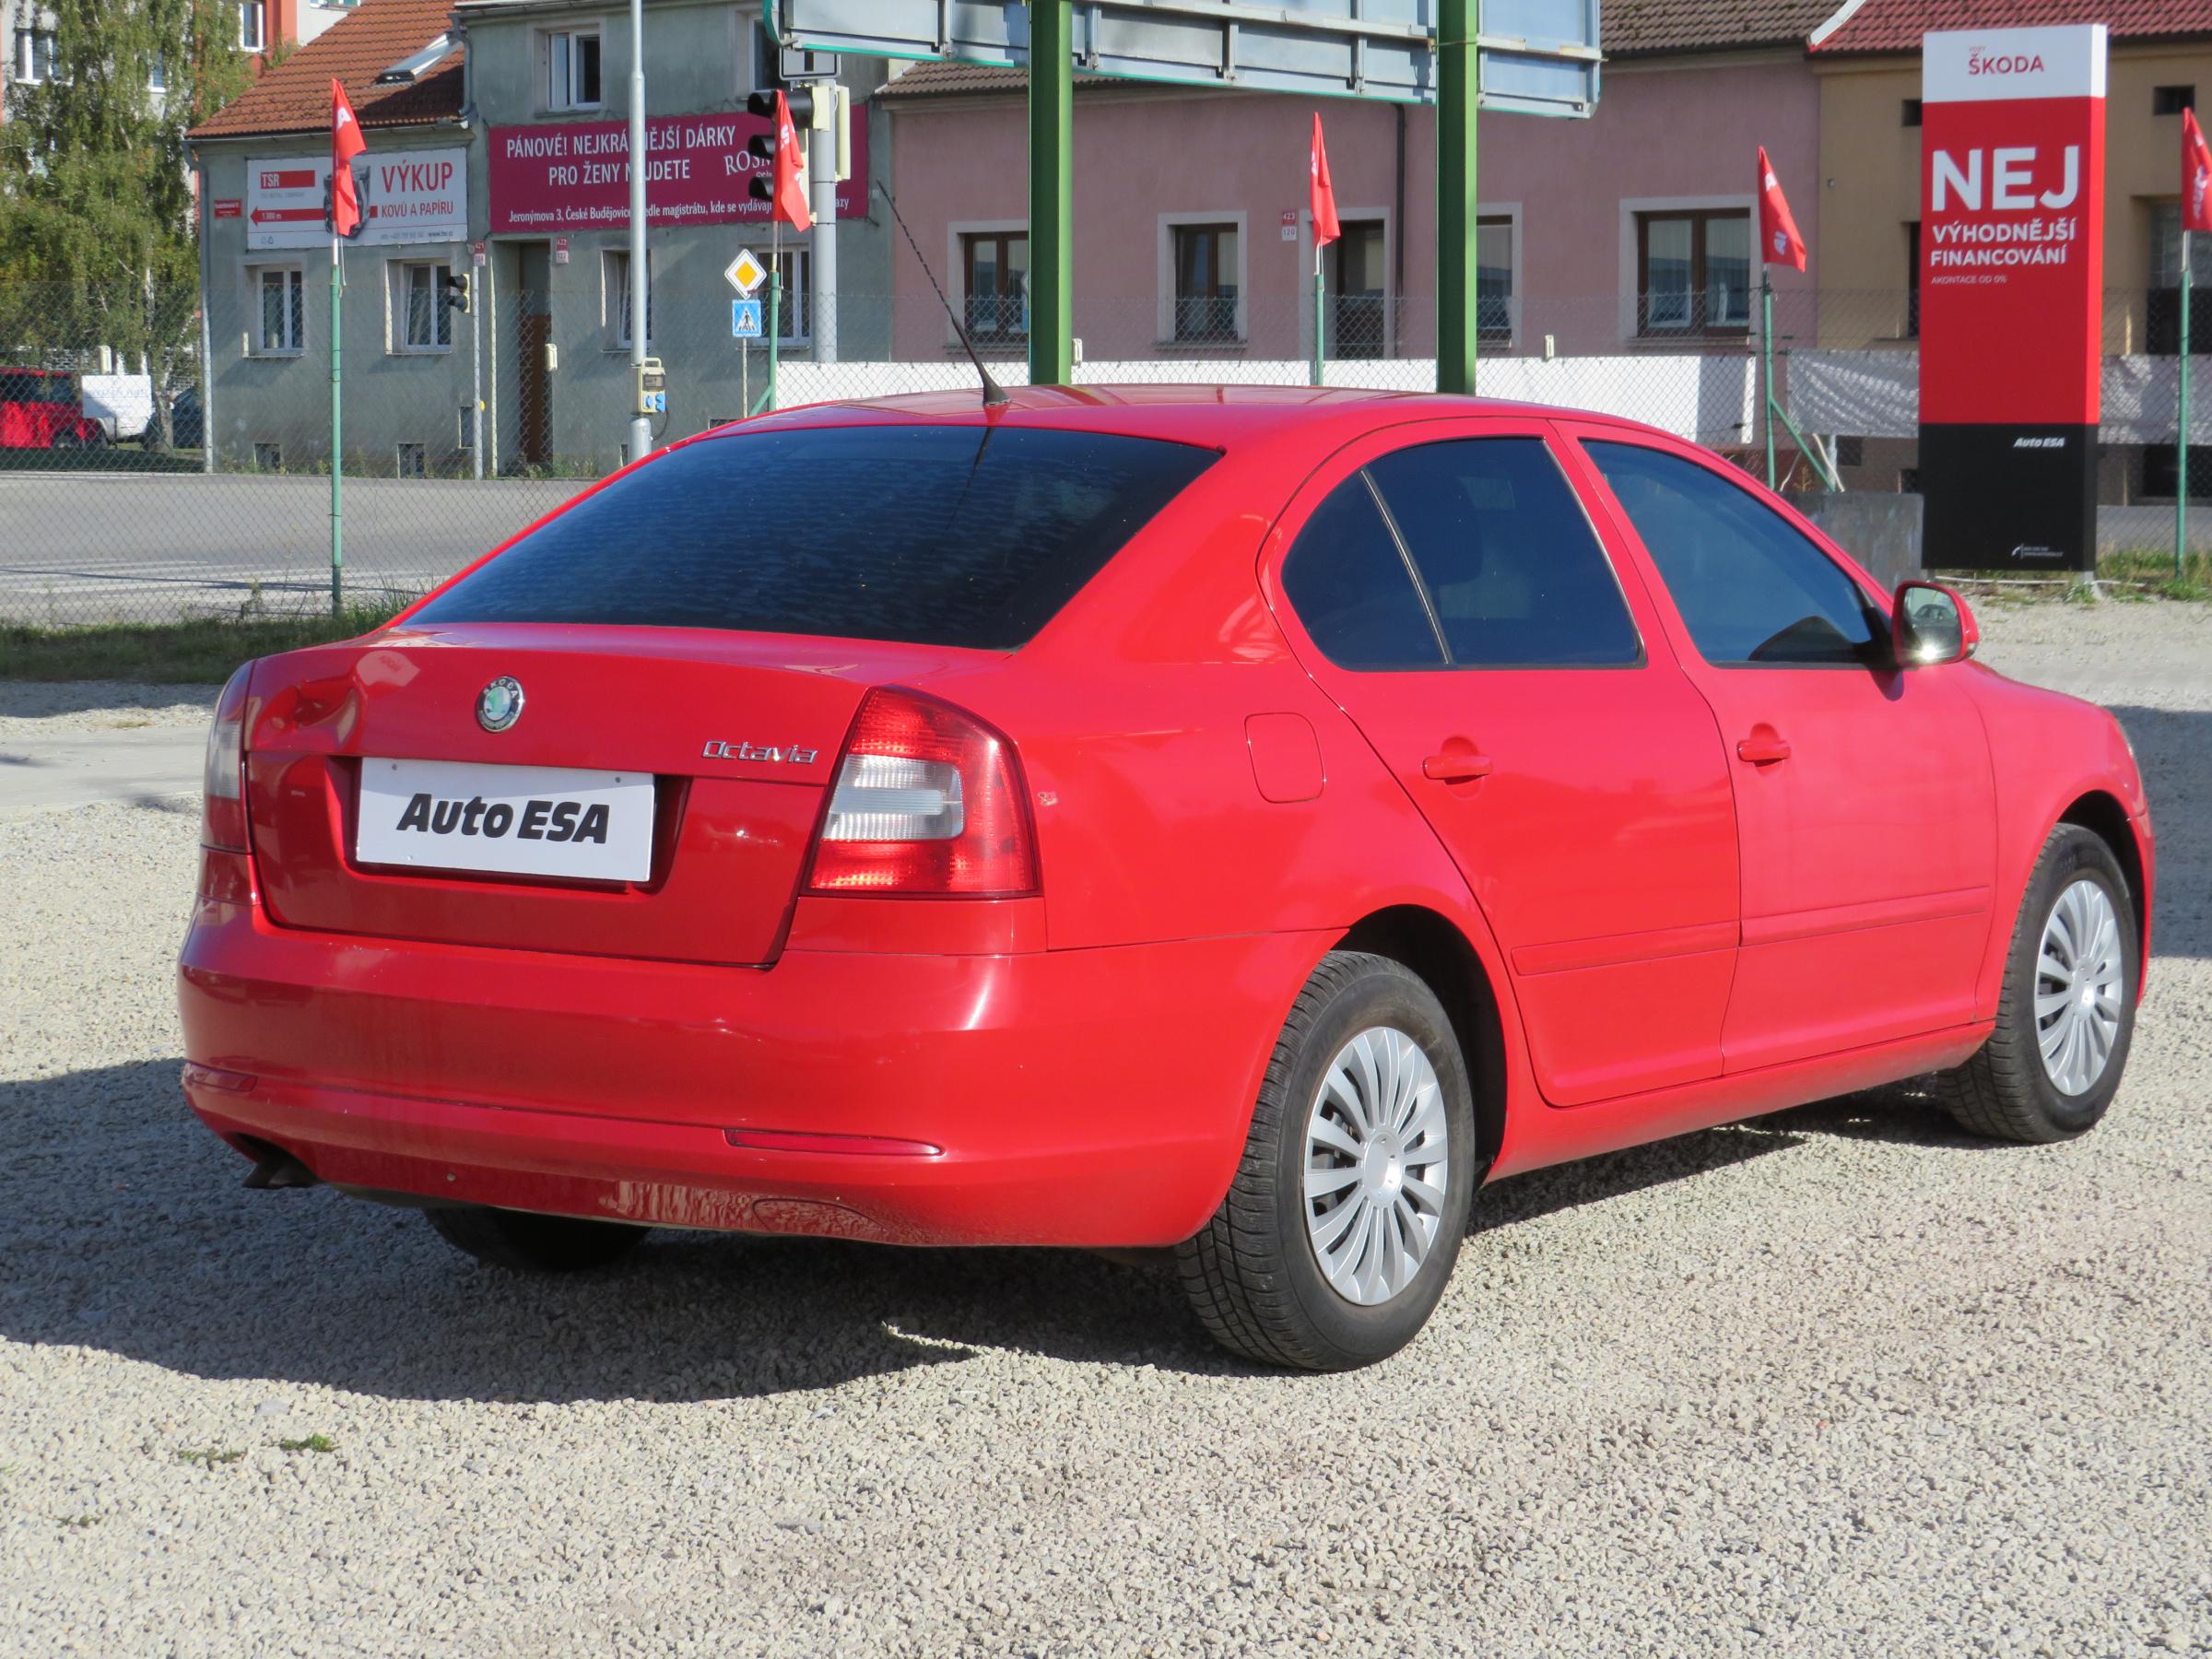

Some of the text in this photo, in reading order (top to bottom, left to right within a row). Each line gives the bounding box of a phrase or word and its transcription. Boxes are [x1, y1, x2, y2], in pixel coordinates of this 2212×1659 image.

[1969, 53, 2044, 76] ŠKODA
[507, 124, 735, 159] PÁNOVÉ! NEJKRÁĚJŠÍ DÁRKY
[262, 173, 279, 188] TSR
[382, 159, 453, 194] VÝKUP
[549, 159, 690, 186] PRO ŽENY NJDETE
[1932, 145, 2079, 212] NEJ
[382, 198, 453, 218] KOVŮ A PAPÍRU
[509, 208, 555, 225] Jeronýmova
[557, 208, 564, 222] 3,
[566, 205, 588, 219] České
[663, 202, 708, 218] magistrátu,
[711, 200, 725, 214] kde
[727, 204, 736, 213] se
[1282, 212, 1295, 220] 423
[1933, 217, 2077, 244] VÝHODNĚJŠÍ
[1930, 243, 2067, 267] FINANCOVÁNÍ
[2013, 437, 2065, 448] Auto ESA
[702, 740, 818, 764] Octavia
[396, 793, 610, 844] Auto ESA
